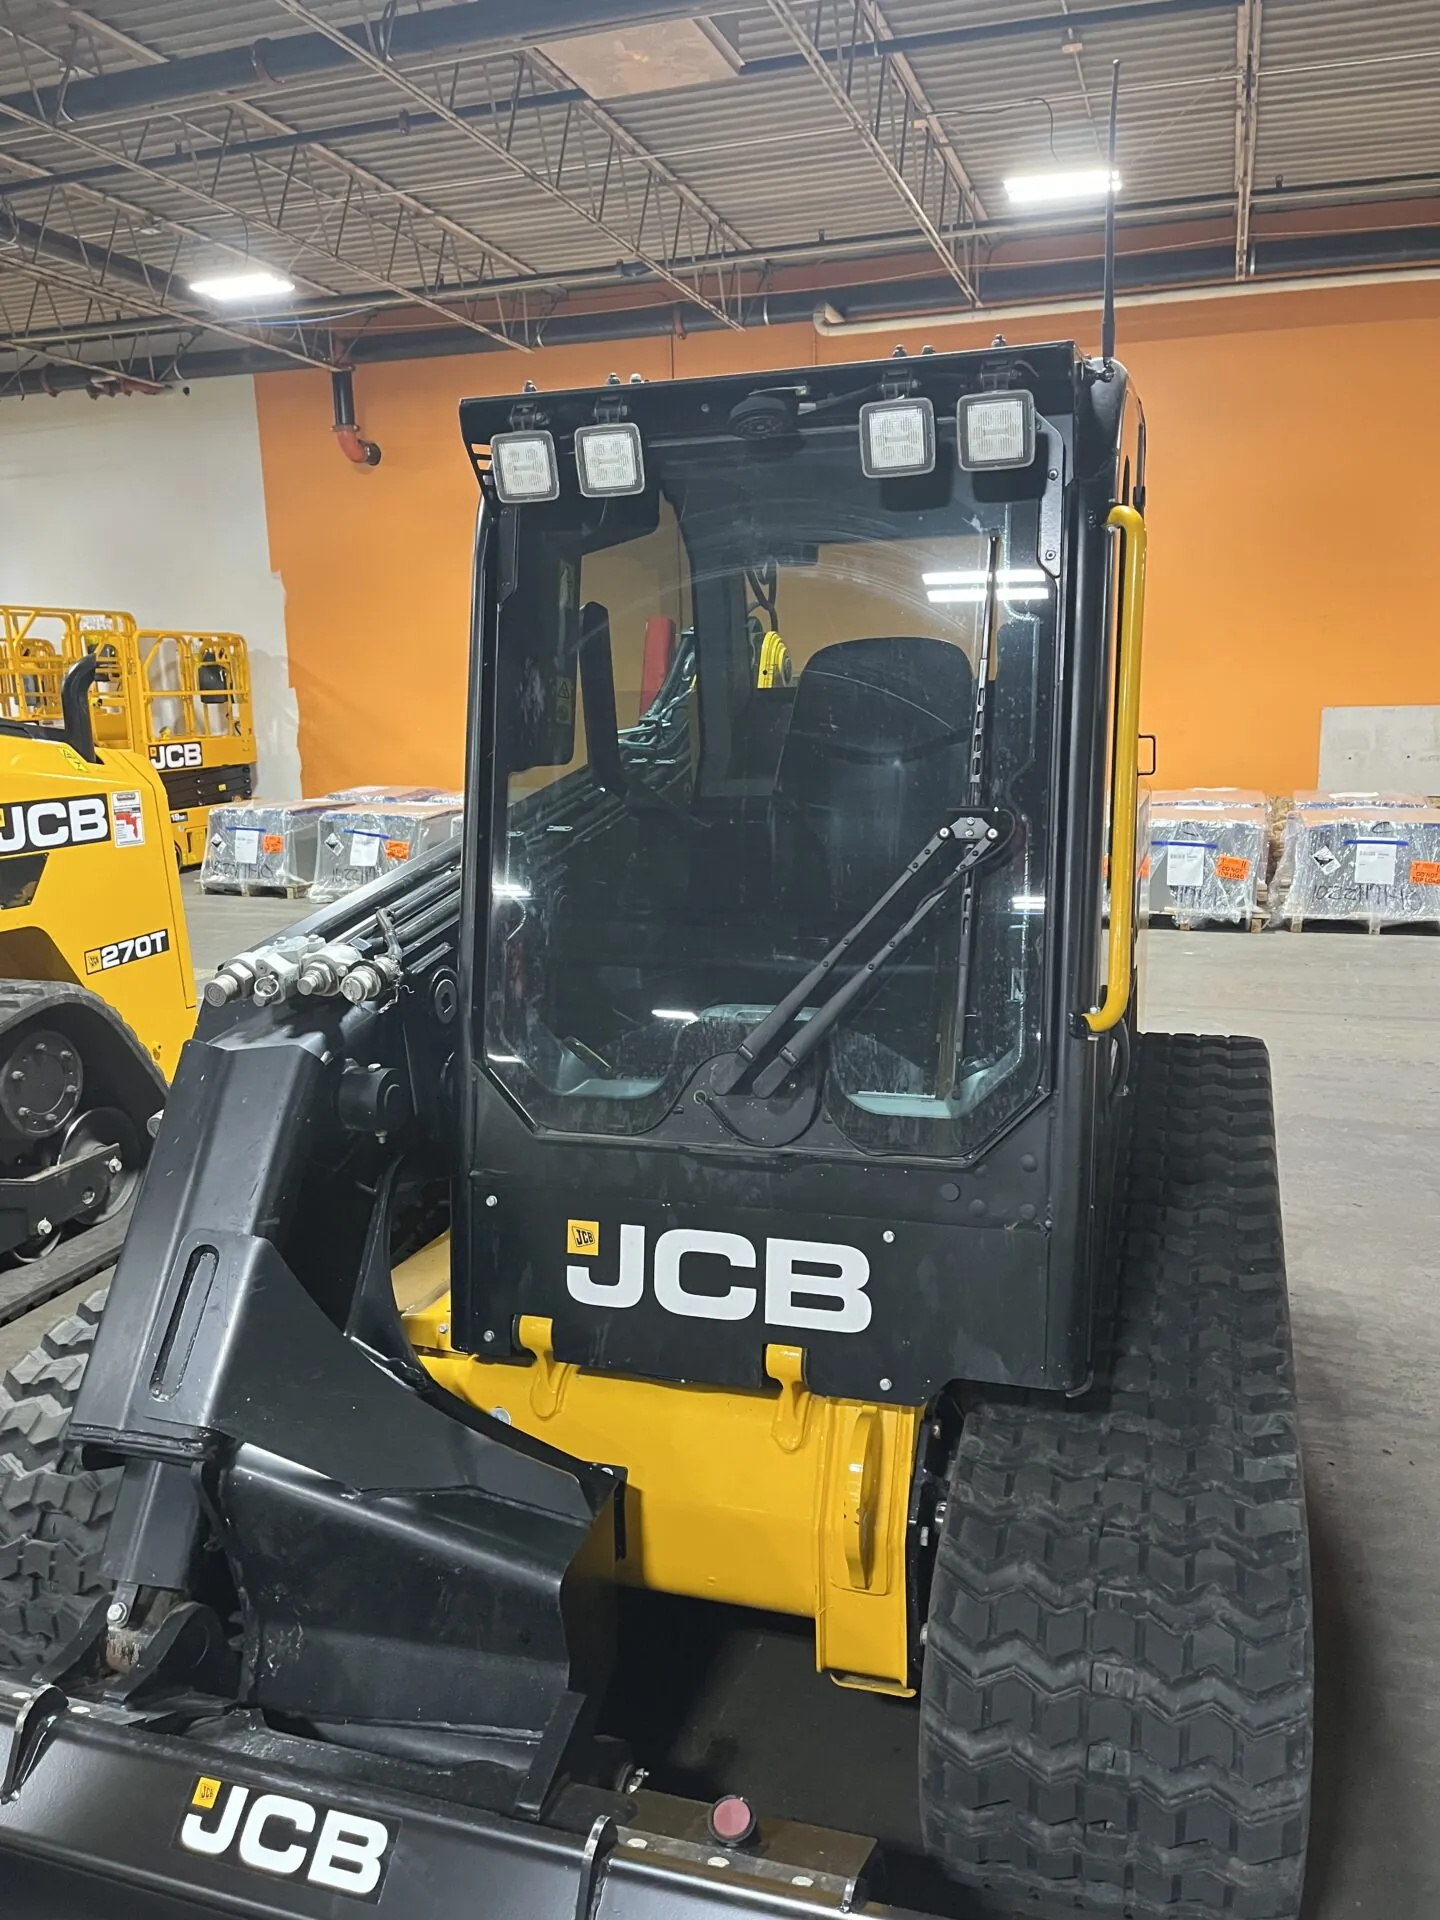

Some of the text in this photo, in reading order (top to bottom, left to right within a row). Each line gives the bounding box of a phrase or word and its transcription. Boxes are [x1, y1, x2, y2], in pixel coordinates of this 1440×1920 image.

[150, 742, 202, 770] JCB
[0, 798, 109, 853] JCB
[101, 930, 166, 969] 270T
[576, 1229, 594, 1246] JCB
[566, 1223, 872, 1334] JCB
[181, 1785, 389, 1895] JCB
